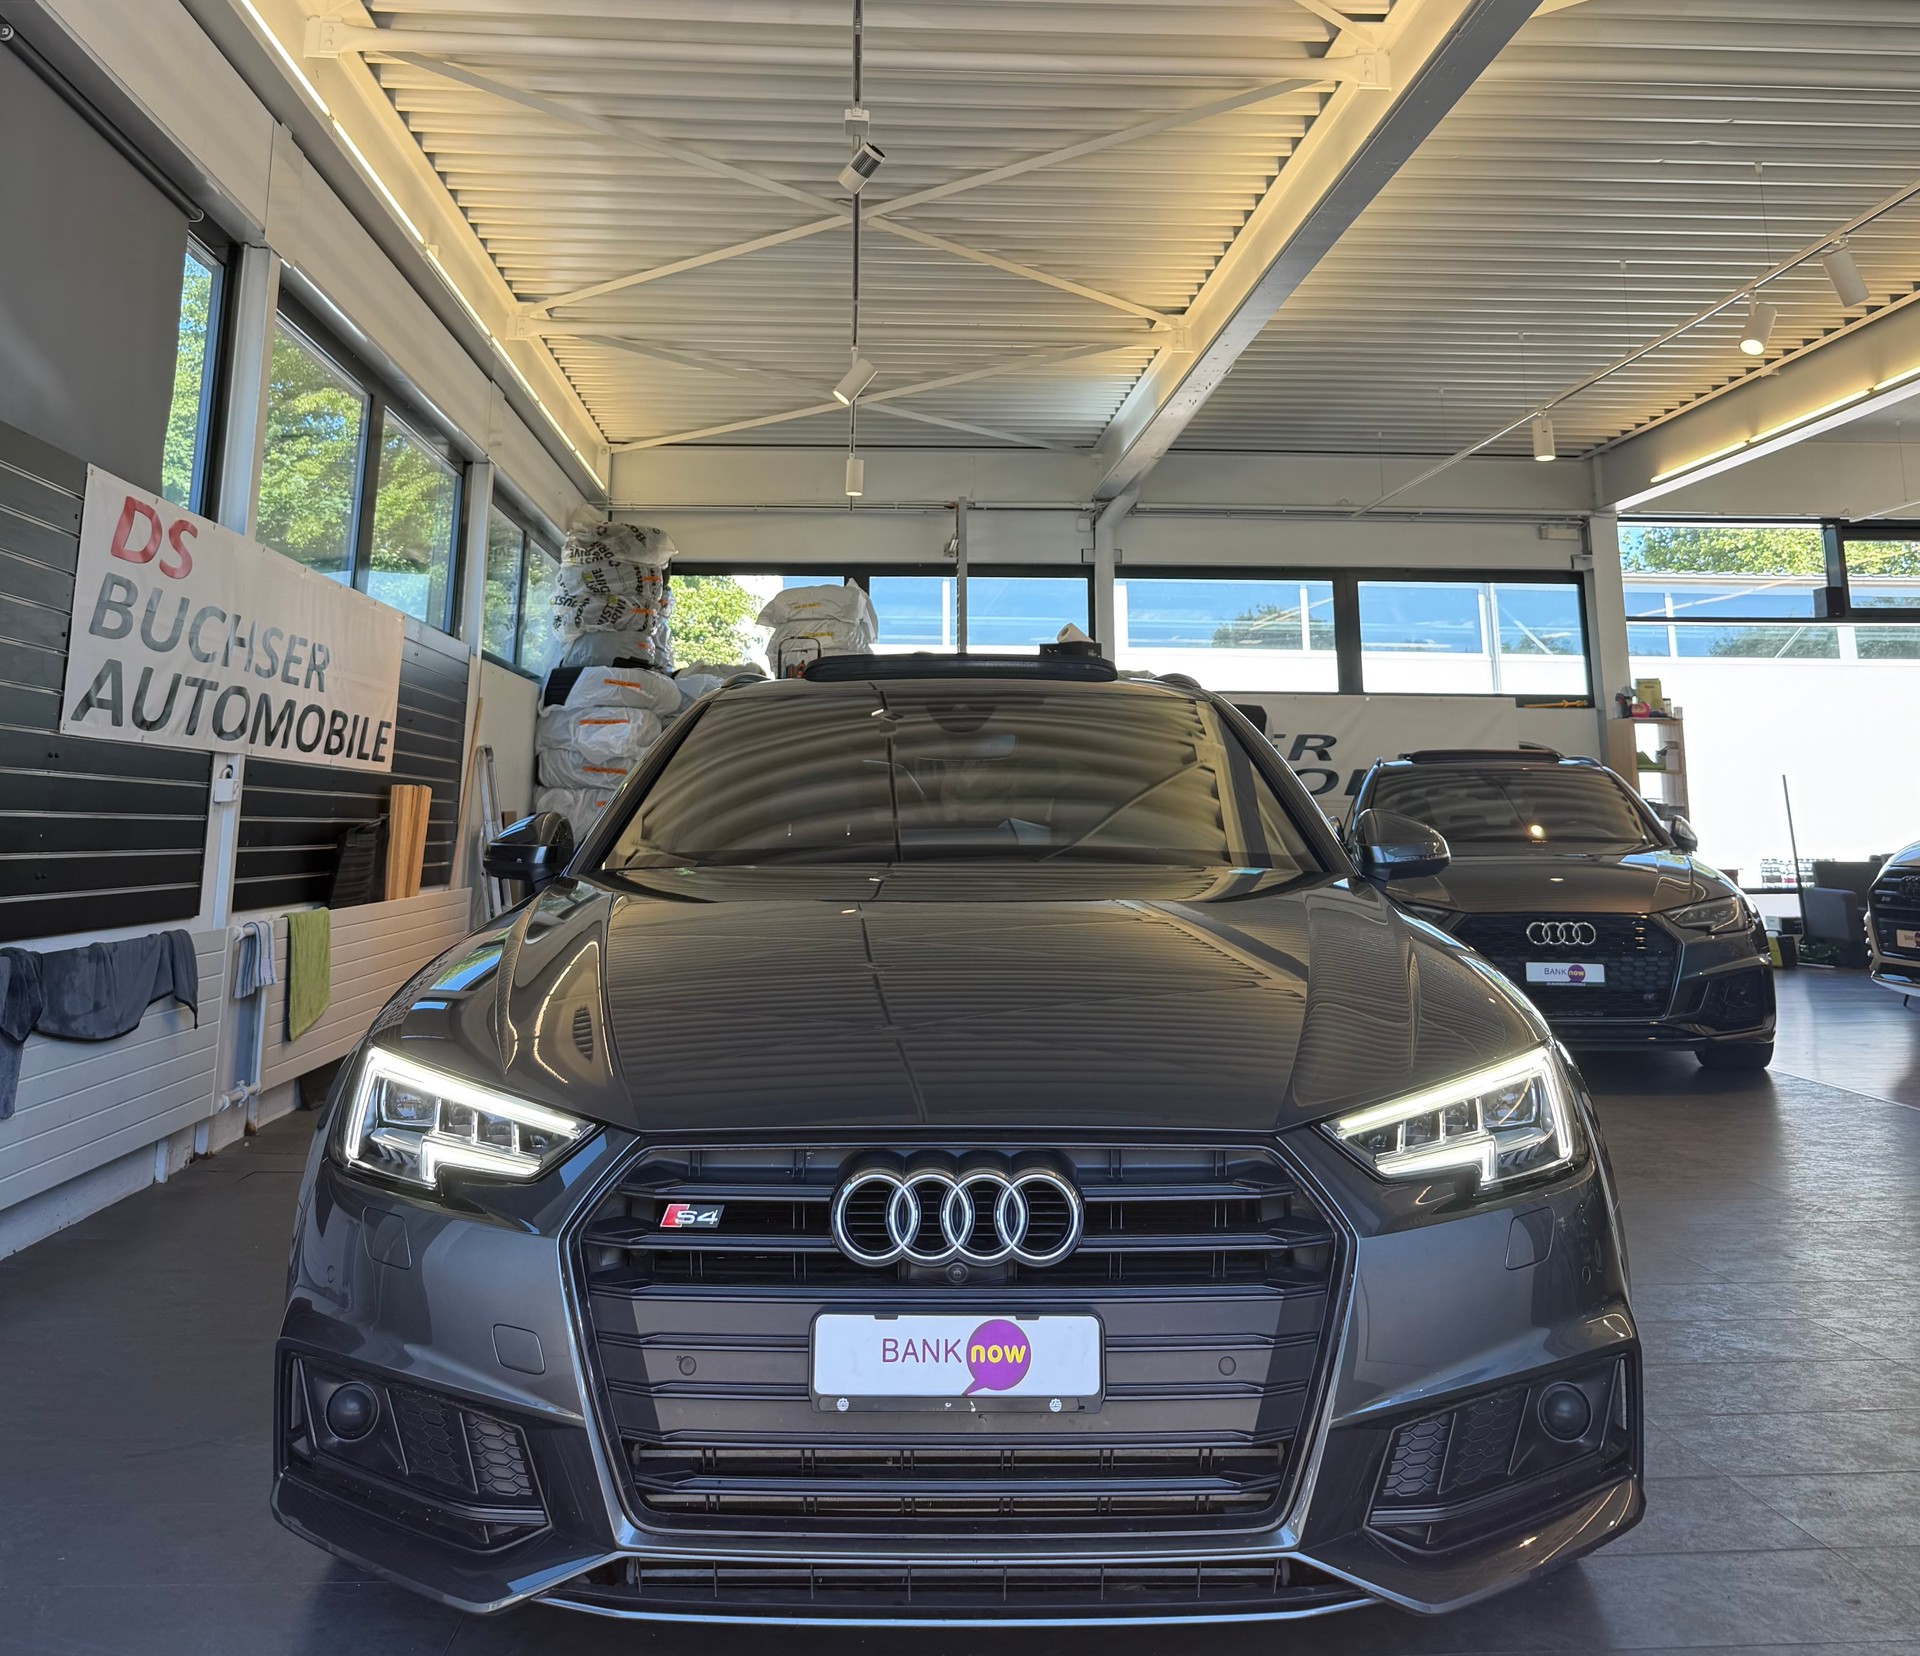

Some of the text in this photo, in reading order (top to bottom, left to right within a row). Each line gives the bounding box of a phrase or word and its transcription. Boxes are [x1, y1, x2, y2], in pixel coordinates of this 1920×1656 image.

[110, 496, 198, 579] DS
[89, 572, 330, 692] BUCHSER
[71, 658, 392, 763] AUTOMOBILE
[675, 1209, 719, 1225] S4
[882, 1338, 1026, 1364] BANK now
